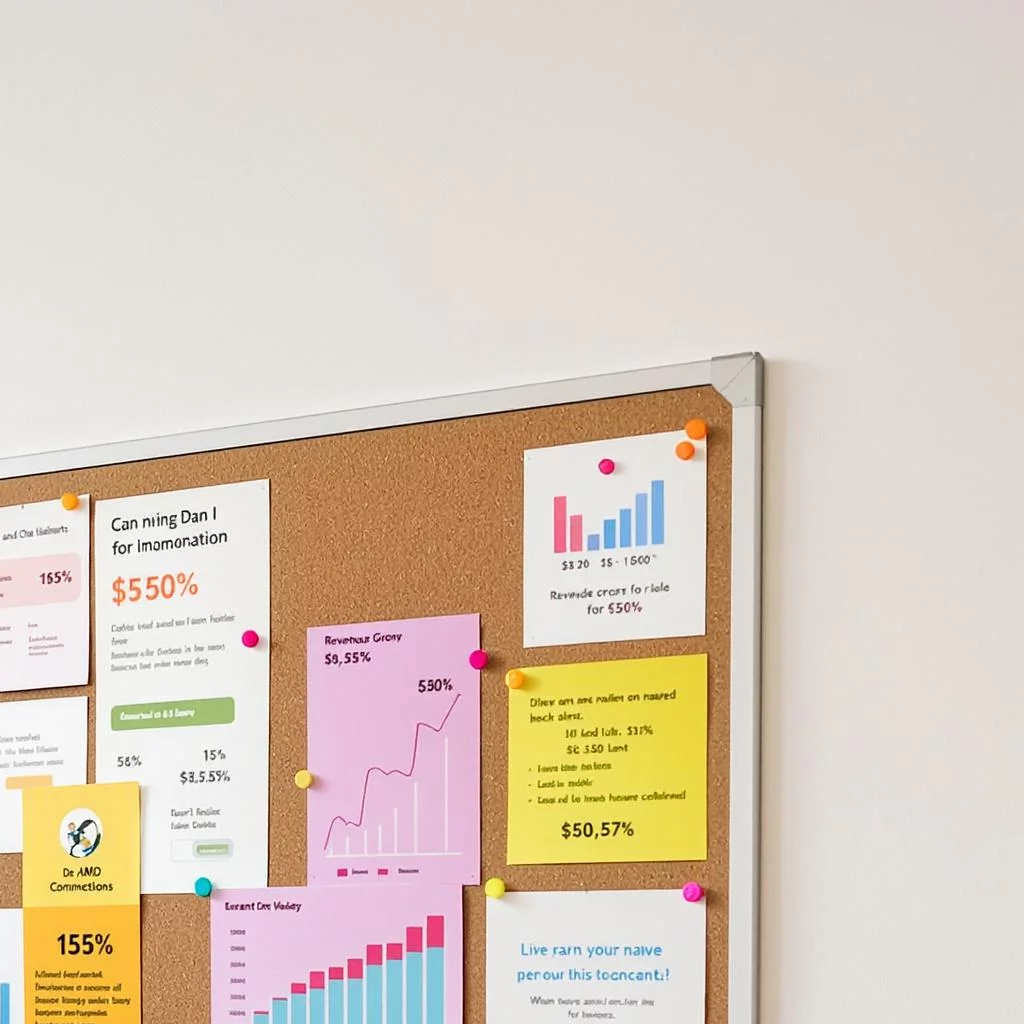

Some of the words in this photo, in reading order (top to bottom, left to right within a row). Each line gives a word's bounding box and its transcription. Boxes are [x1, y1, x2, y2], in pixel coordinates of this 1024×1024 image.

[111, 517, 138, 532] Can
[181, 510, 208, 524] Dan
[112, 540, 133, 555] for
[112, 572, 198, 606] $550%
[587, 605, 604, 615] for
[561, 821, 634, 839] $50,57%
[57, 933, 113, 955] 155%
[521, 943, 548, 956] Live
[588, 946, 619, 958] your
